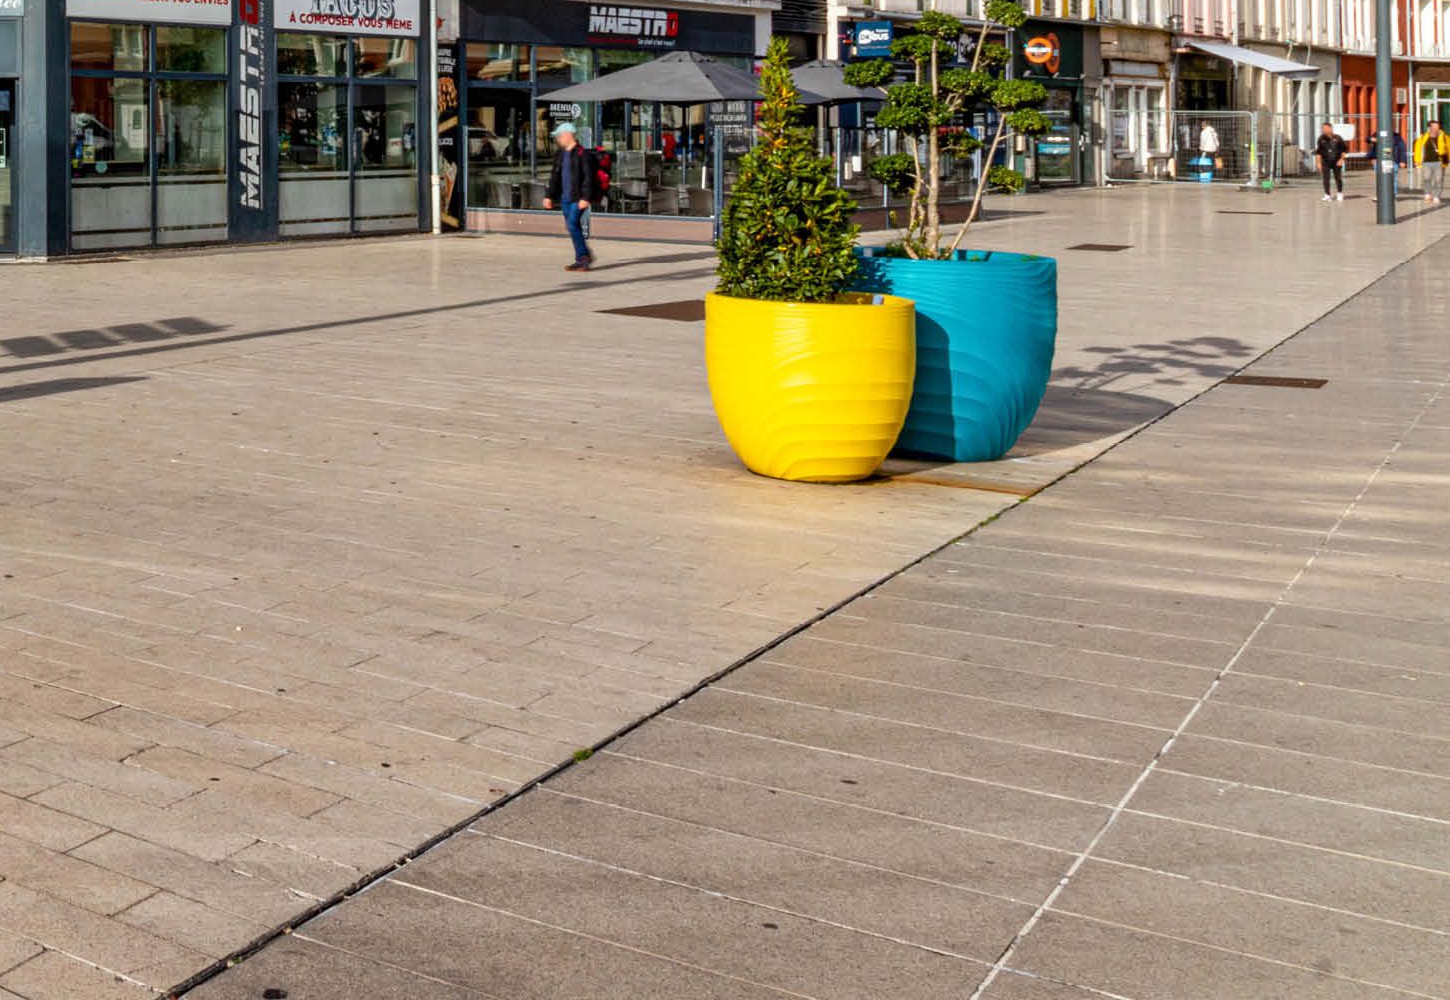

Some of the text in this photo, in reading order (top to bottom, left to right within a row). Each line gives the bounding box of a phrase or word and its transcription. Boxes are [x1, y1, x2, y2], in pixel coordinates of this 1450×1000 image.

[299, 13, 355, 27] COMPOSER
[358, 17, 383, 29] VOUS
[589, 6, 679, 37] MAESTRO
[550, 103, 571, 111] MENU
